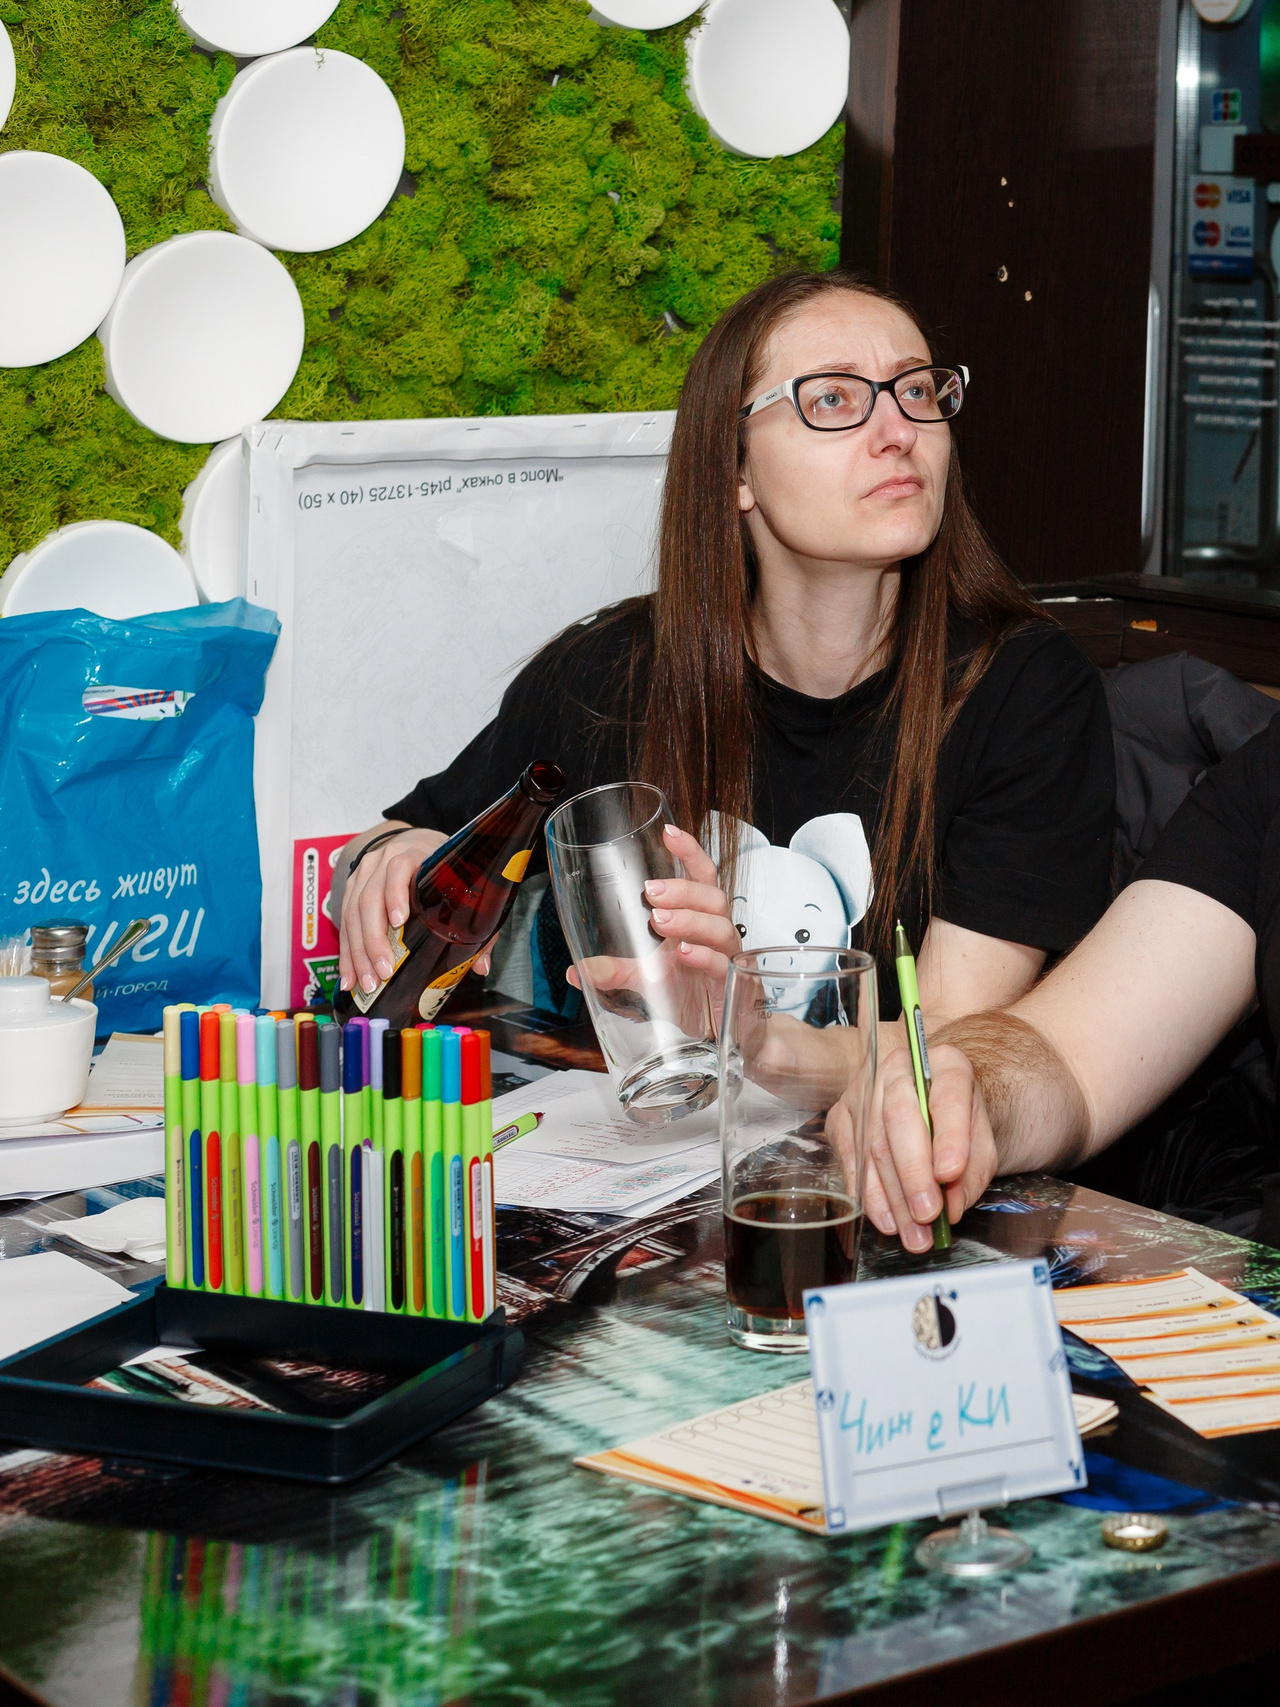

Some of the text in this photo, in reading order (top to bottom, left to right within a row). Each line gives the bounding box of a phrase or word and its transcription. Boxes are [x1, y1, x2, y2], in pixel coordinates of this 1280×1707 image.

[13, 863, 198, 905] здесь живут
[270, 1182, 278, 1217] Schneider
